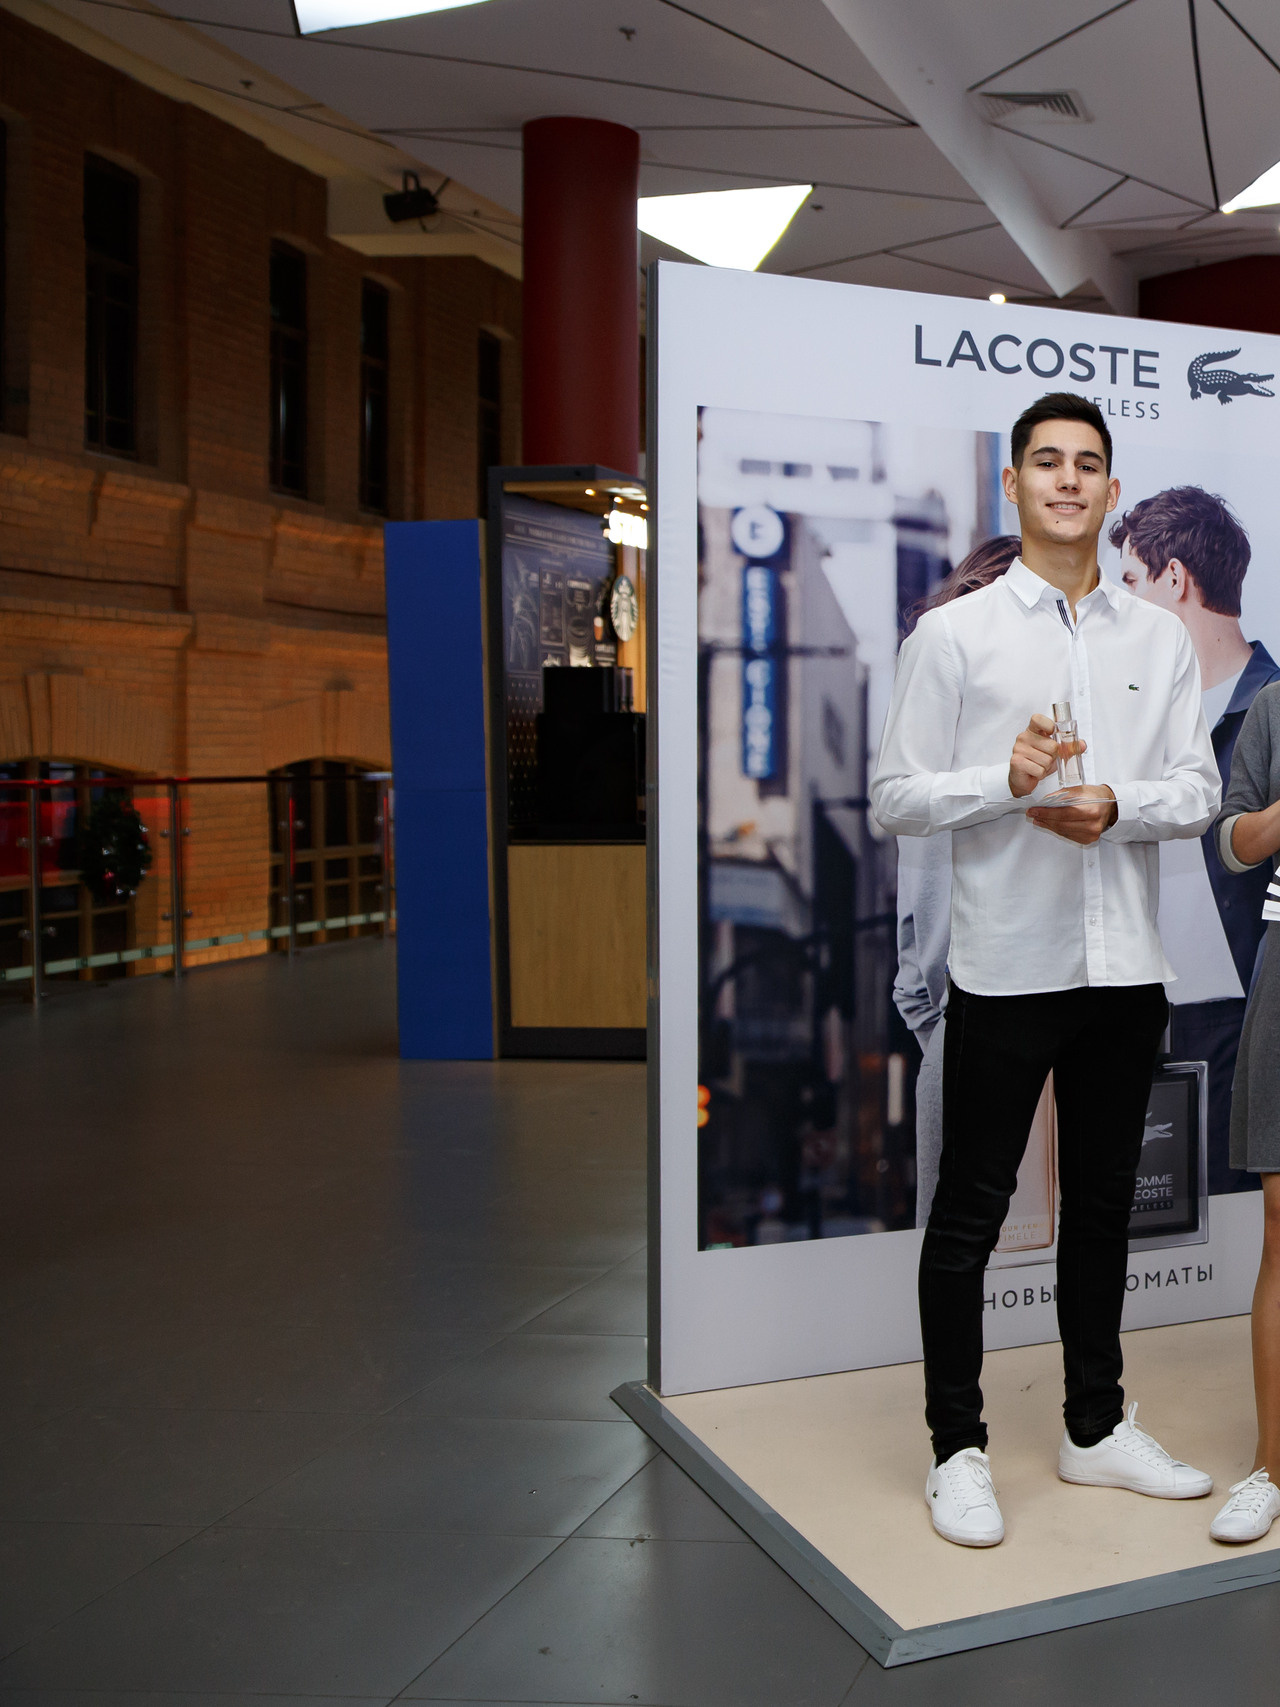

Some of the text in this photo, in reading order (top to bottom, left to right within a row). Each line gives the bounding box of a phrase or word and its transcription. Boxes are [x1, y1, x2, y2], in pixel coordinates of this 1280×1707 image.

[915, 324, 1160, 389] LACOSTE
[1094, 397, 1160, 420] ELESS
[1136, 1173, 1173, 1188] OMME
[1134, 1186, 1173, 1200] COSTE
[1000, 1231, 1044, 1242] IMELE
[1002, 1225, 1018, 1233] OUR
[984, 1263, 1212, 1310] НОВЫ ОМАТЫ
